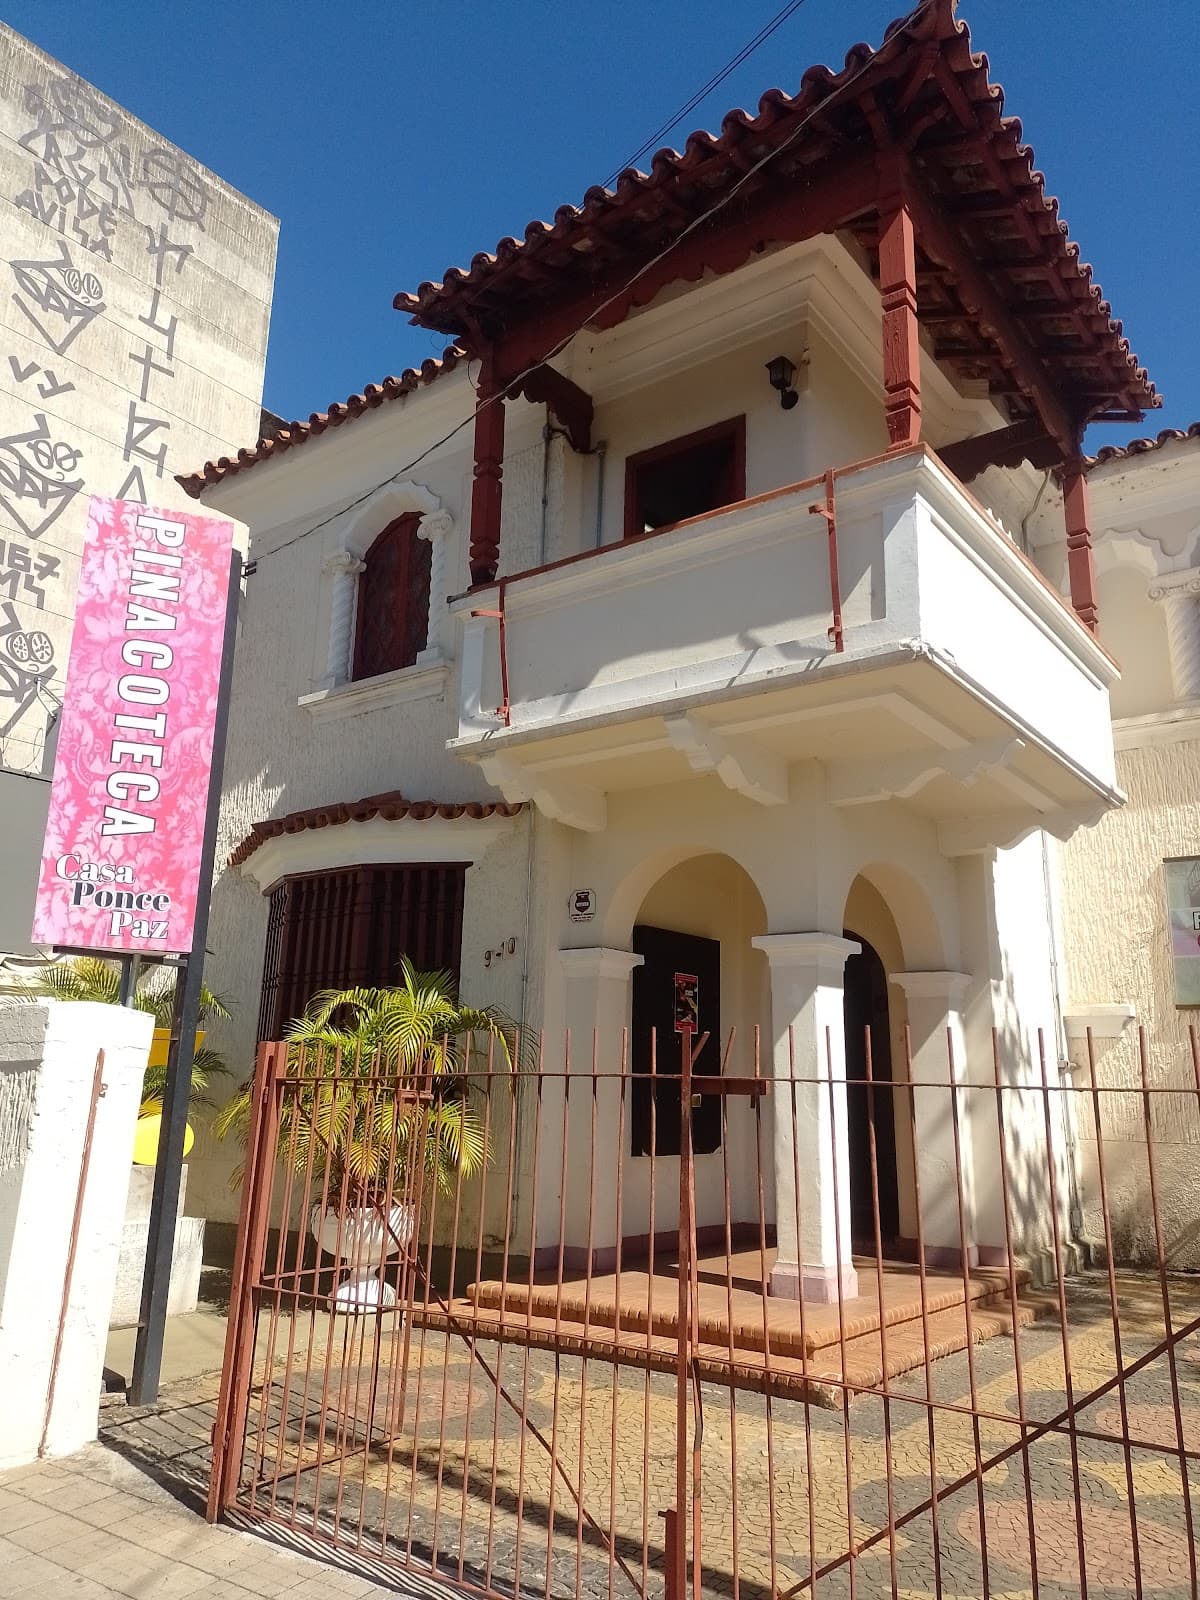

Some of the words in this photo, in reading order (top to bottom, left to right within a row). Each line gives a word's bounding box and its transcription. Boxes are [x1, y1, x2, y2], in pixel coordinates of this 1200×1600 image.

[101, 515, 186, 838] PINACOTECA
[55, 854, 135, 884] Casa
[72, 881, 171, 912] Ponce
[108, 910, 169, 939] Paz
[484, 937, 516, 968] 9-10
